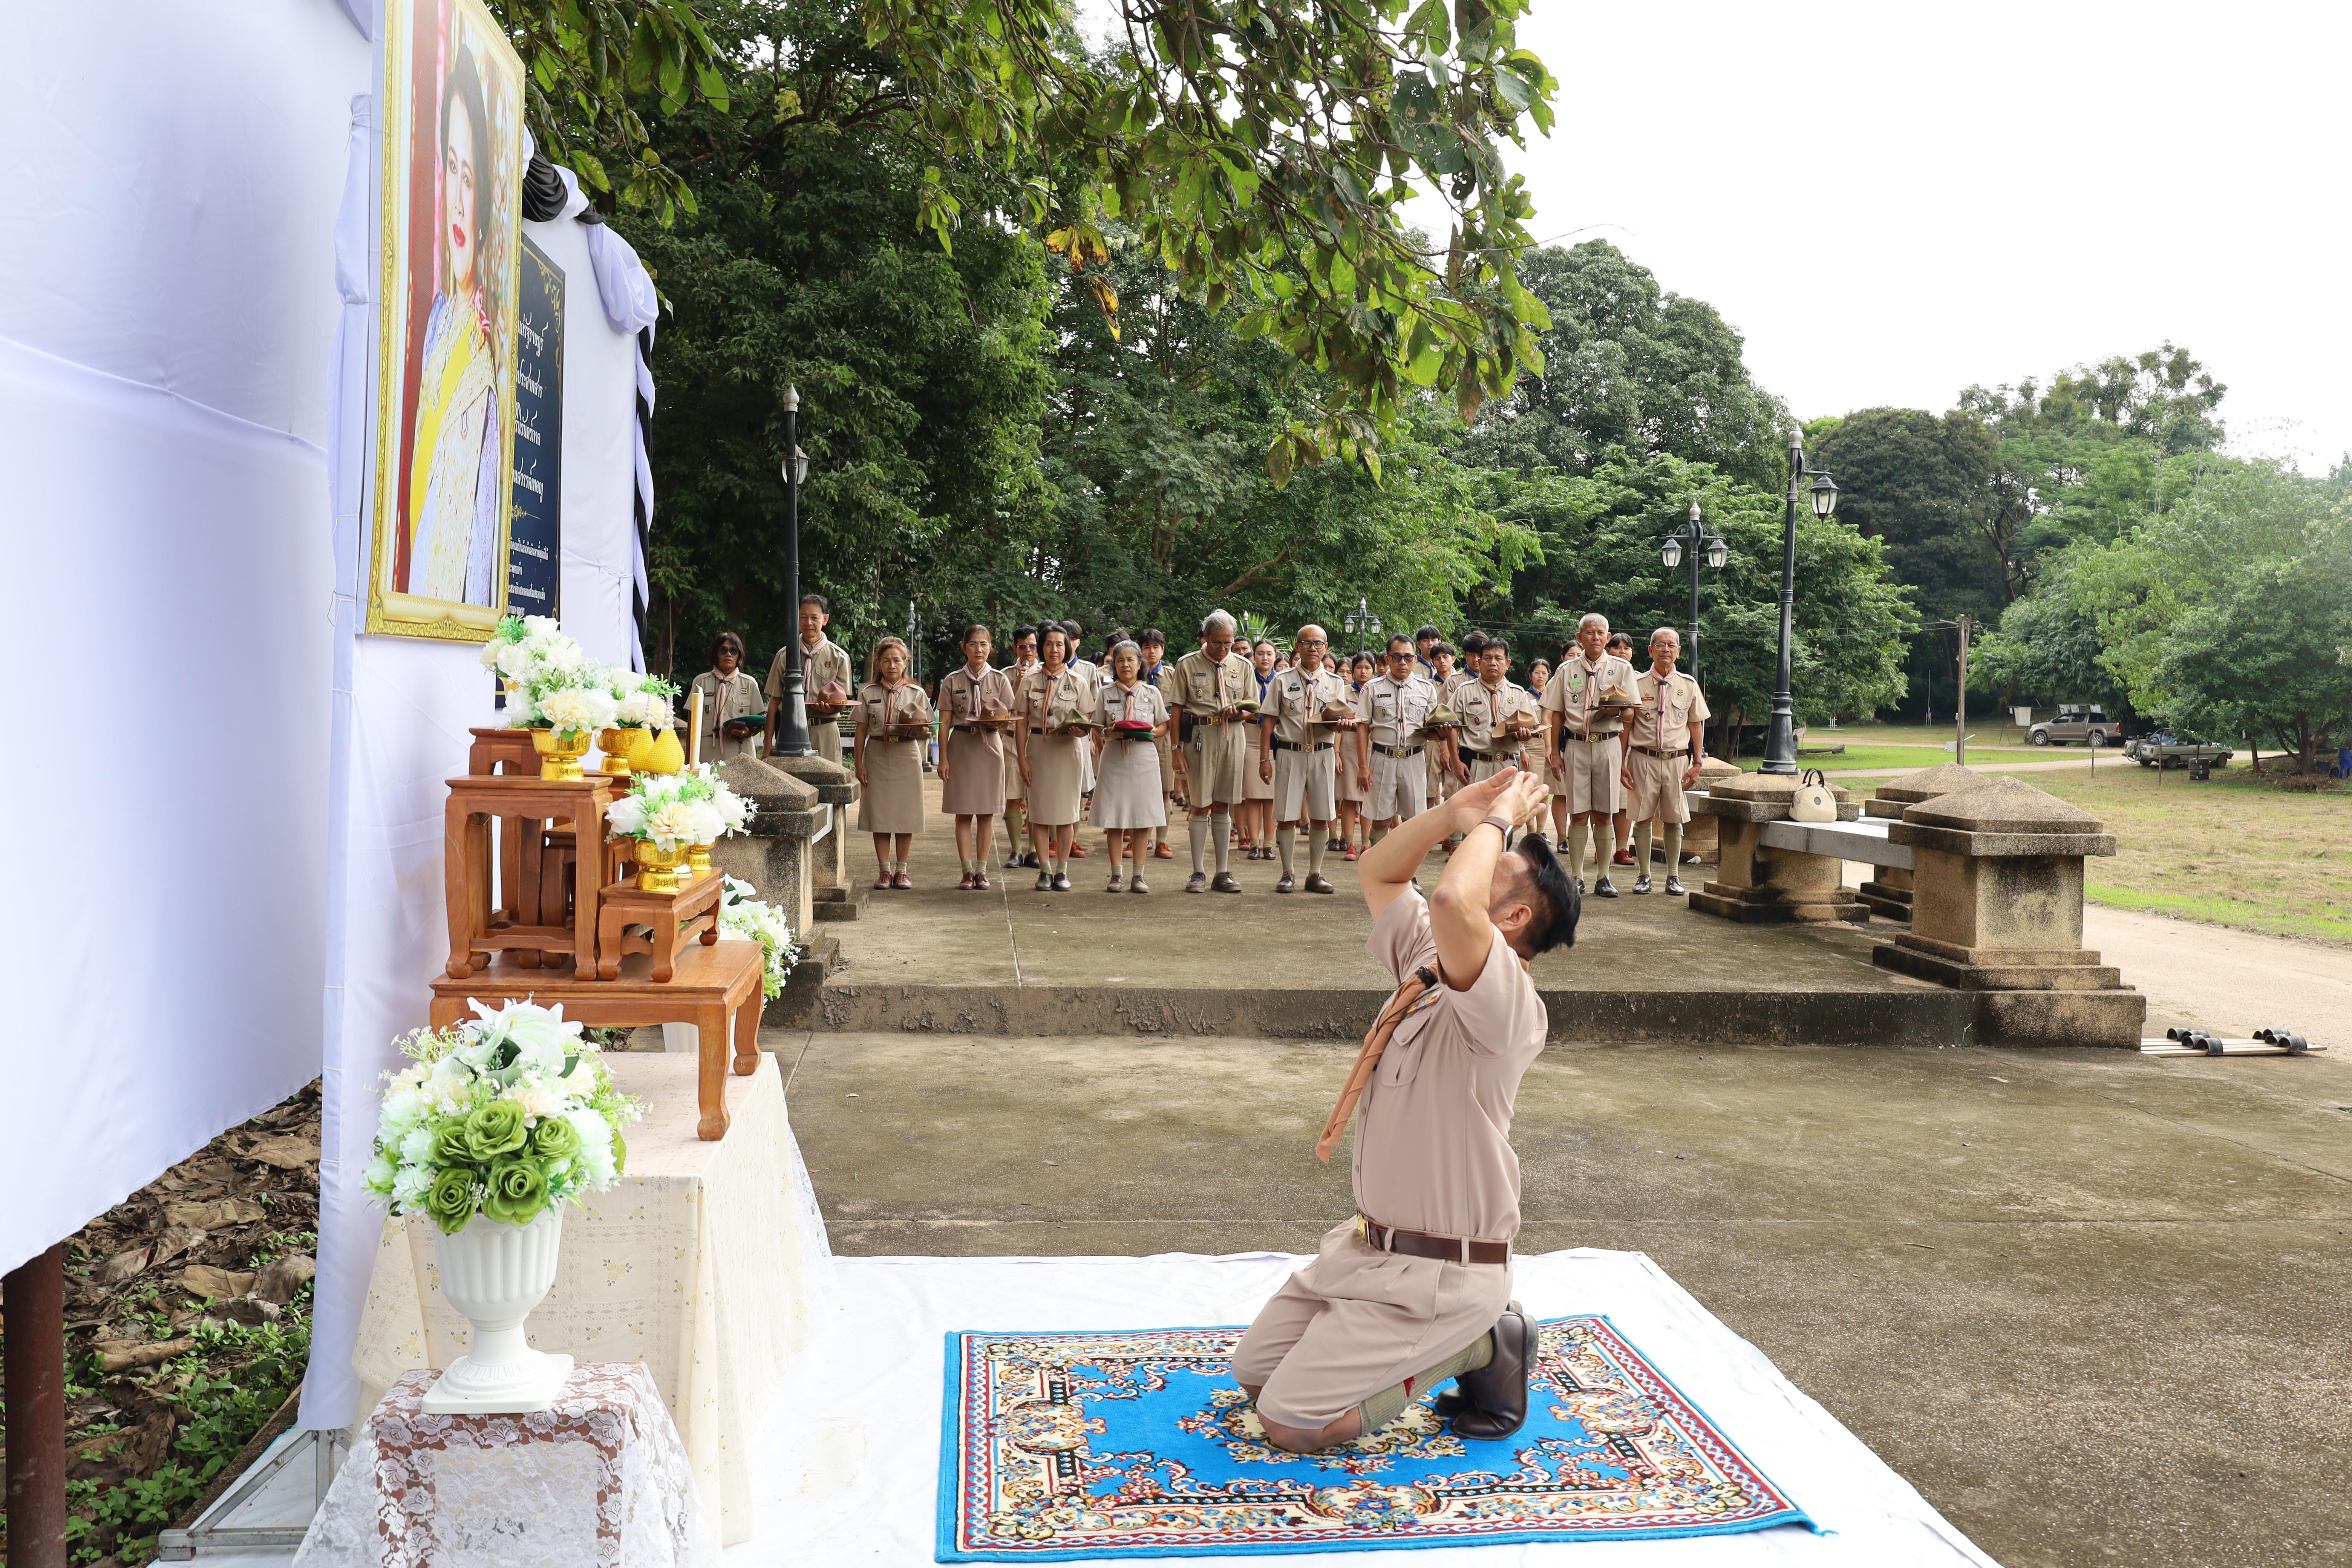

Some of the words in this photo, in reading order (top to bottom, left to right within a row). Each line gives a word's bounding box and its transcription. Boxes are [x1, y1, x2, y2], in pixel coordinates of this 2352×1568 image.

[513, 457, 543, 503] นสวรรค์เทอญ
